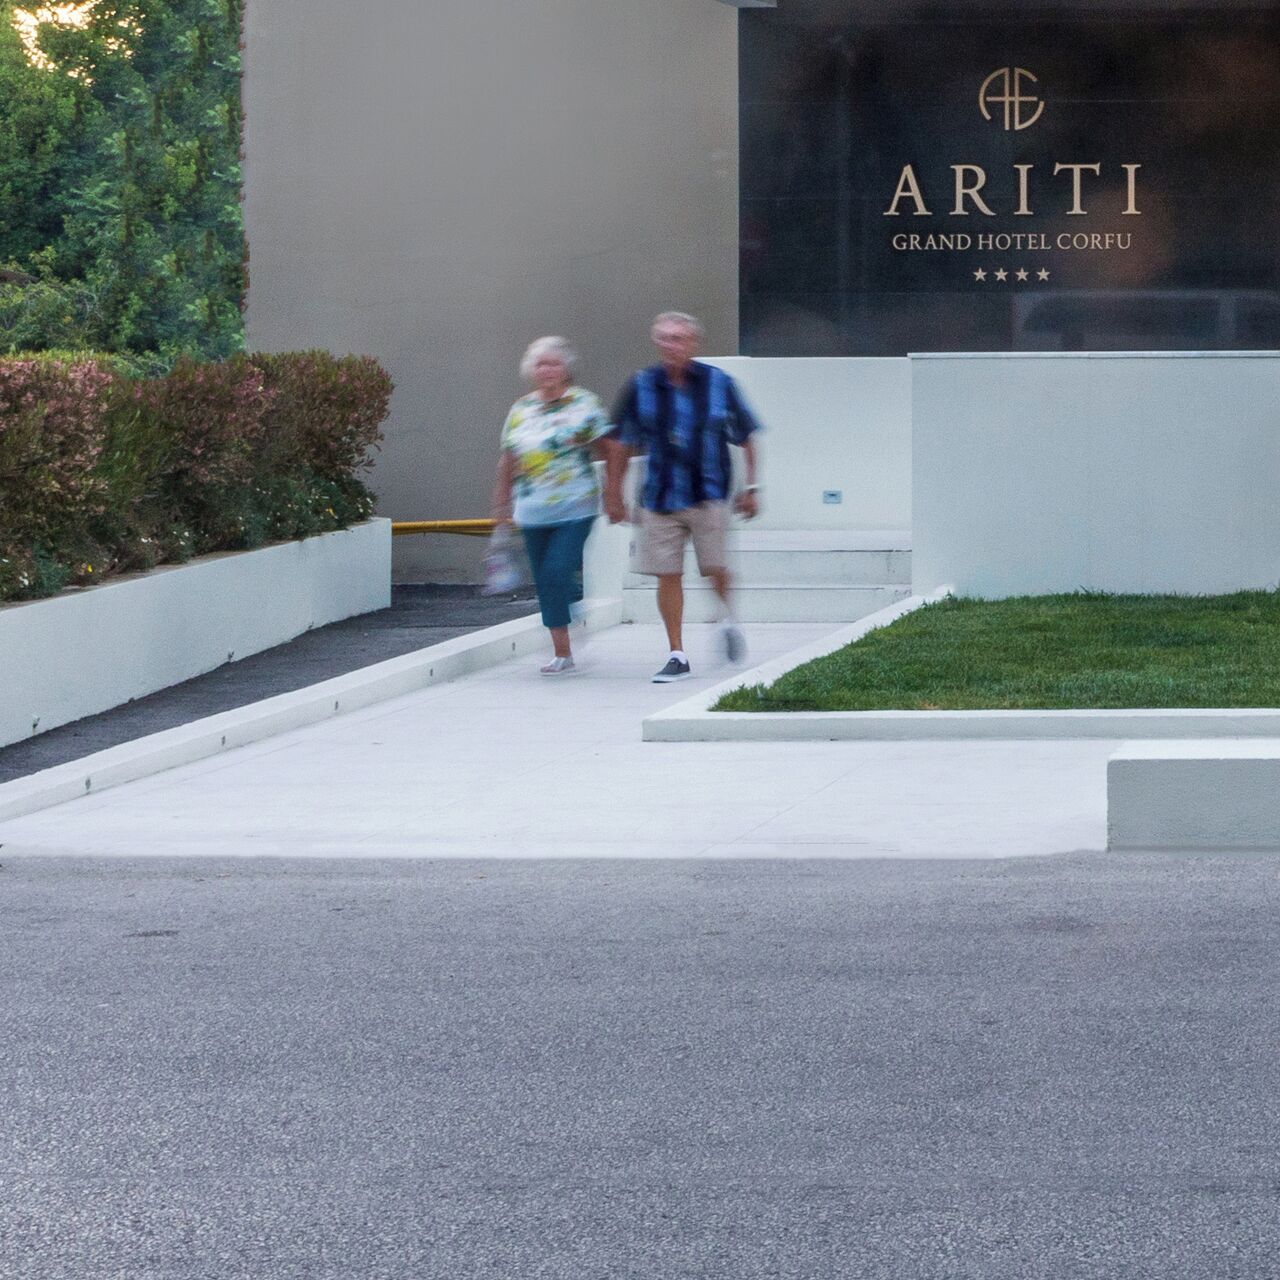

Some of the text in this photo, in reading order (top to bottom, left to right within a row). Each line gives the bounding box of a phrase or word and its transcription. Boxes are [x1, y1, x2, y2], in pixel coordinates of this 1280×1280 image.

[882, 162, 1142, 217] ARITI
[892, 232, 1133, 251] GRAND HOTEL CORFU
